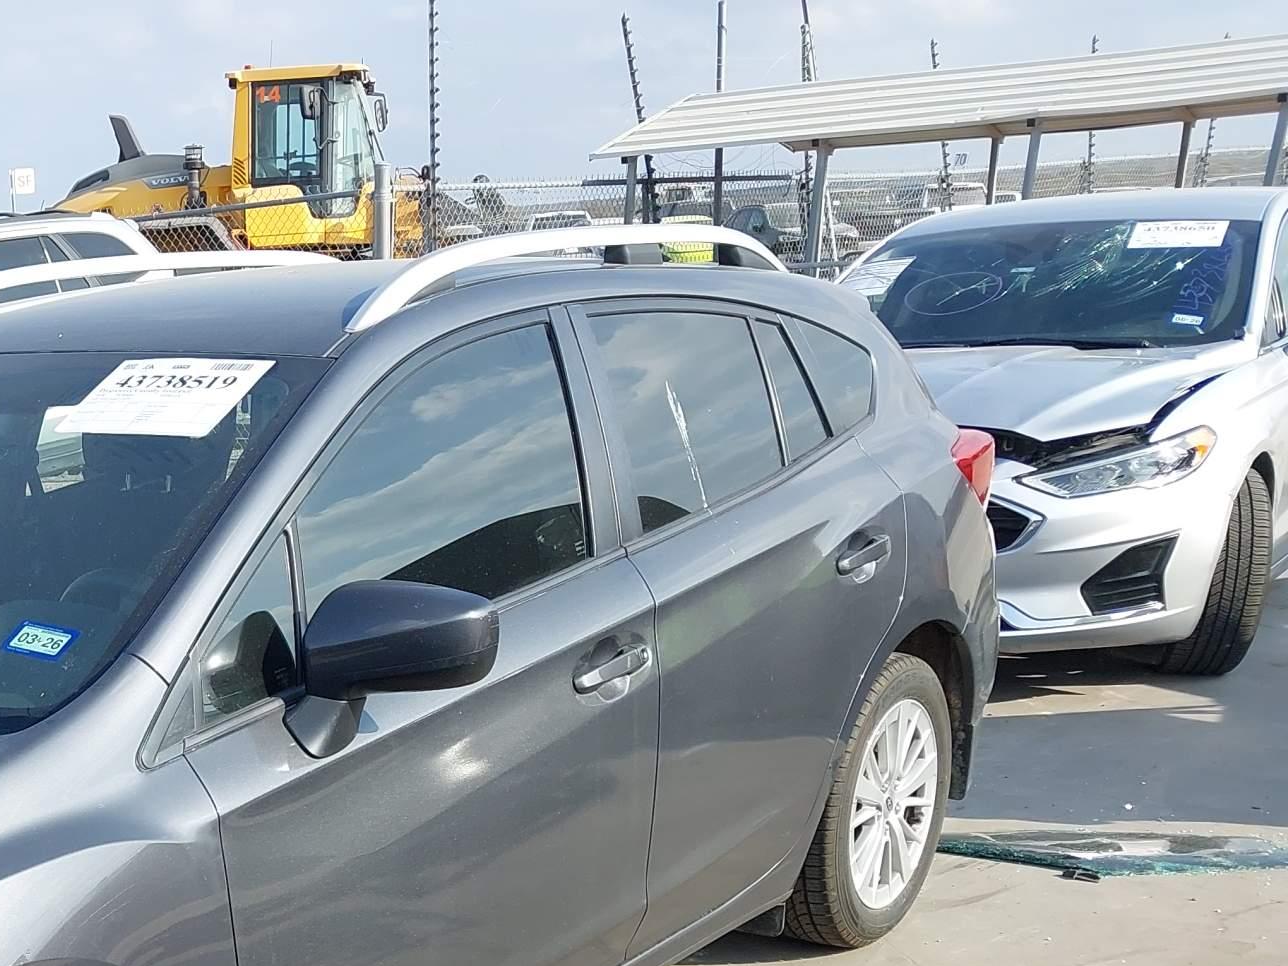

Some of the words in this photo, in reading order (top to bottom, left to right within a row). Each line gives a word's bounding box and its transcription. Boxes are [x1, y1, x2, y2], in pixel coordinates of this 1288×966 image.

[255, 85, 281, 104] 14
[115, 374, 238, 391] 43738519
[17, 632, 39, 645] 03
[41, 637, 64, 650] 26
